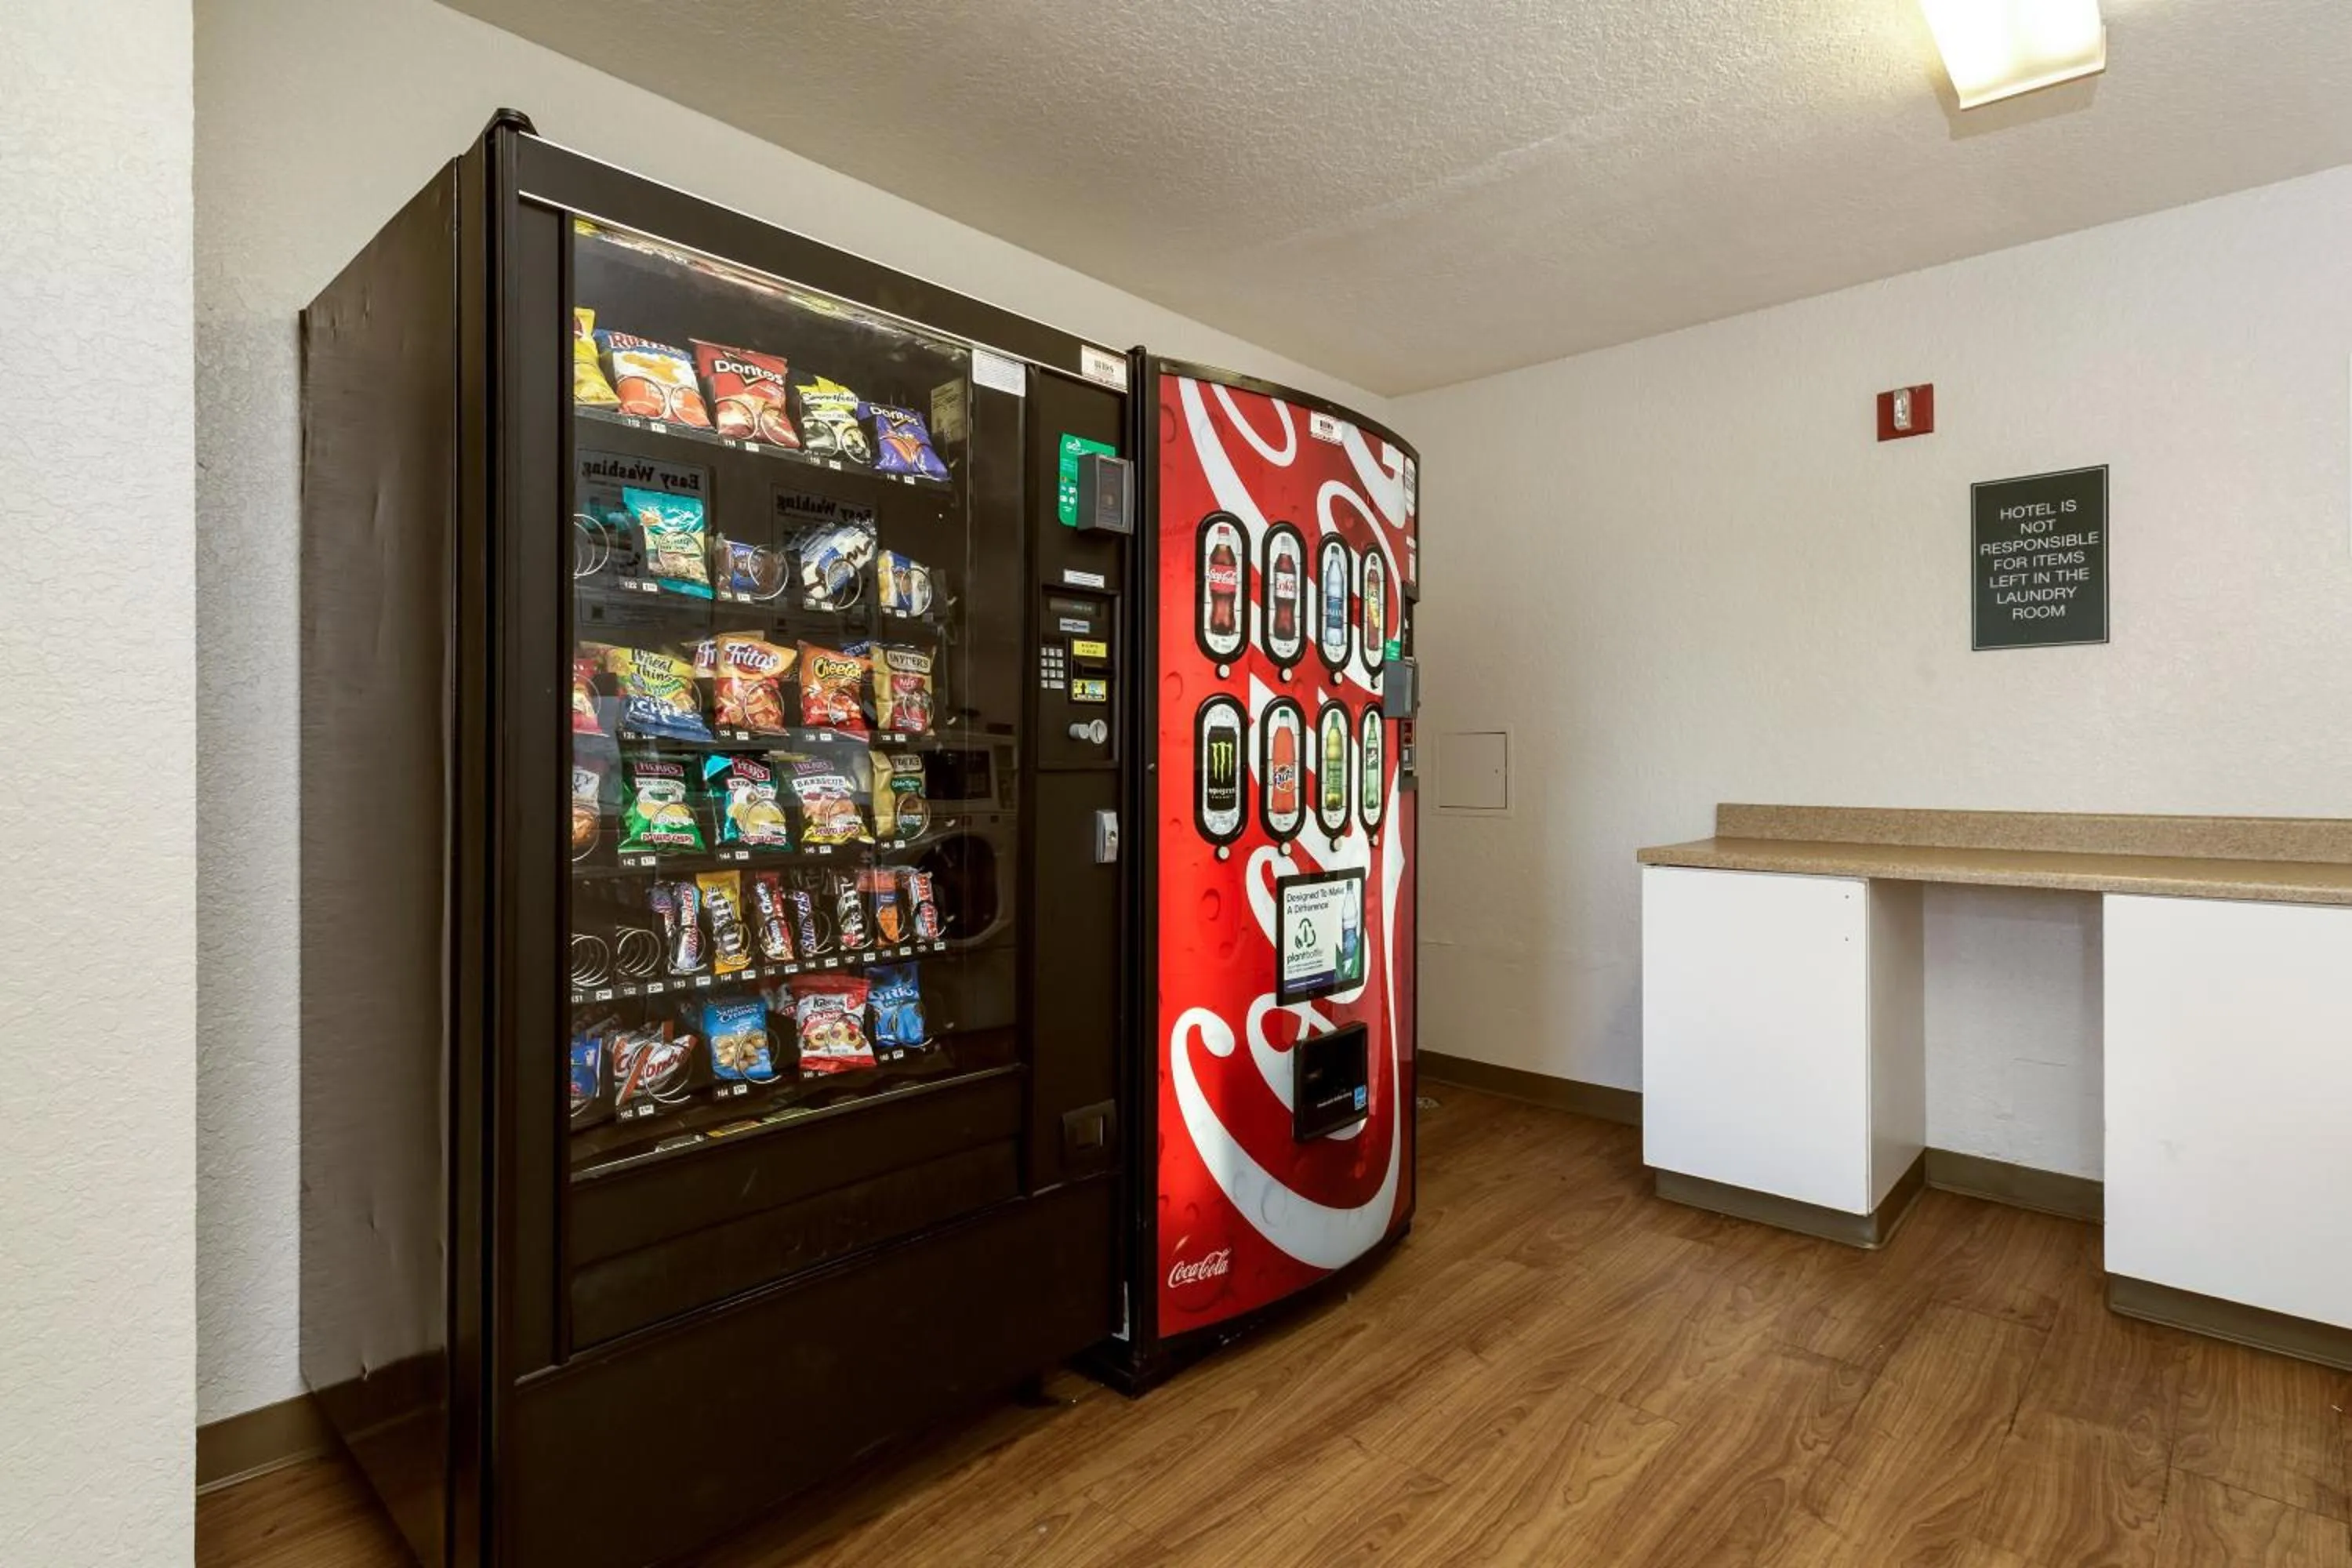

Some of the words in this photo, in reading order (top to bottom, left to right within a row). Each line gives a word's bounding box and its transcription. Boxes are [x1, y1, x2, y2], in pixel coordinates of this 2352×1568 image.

[714, 359, 784, 385] Doritos
[869, 405, 919, 426] Doritos
[2000, 503, 2056, 521] HOTEL
[2061, 499, 2078, 514] IS
[2020, 518, 2057, 535] NOT
[1980, 531, 2100, 557] RESPONSIBLE
[1994, 556, 2028, 572] FOR
[2033, 550, 2085, 568] ITEMS
[1989, 573, 2030, 590] LEFT
[2034, 570, 2051, 586] IN
[2055, 567, 2090, 583] THE
[1997, 586, 2078, 605] LAUNDRY
[2012, 604, 2067, 621] ROOM
[724, 642, 779, 672] Fritos
[813, 655, 863, 681] Cheetos
[1287, 891, 1319, 903] Designed
[1287, 906, 1293, 915] A
[1294, 902, 1329, 913] Difference
[793, 891, 817, 951] SNICKERS
